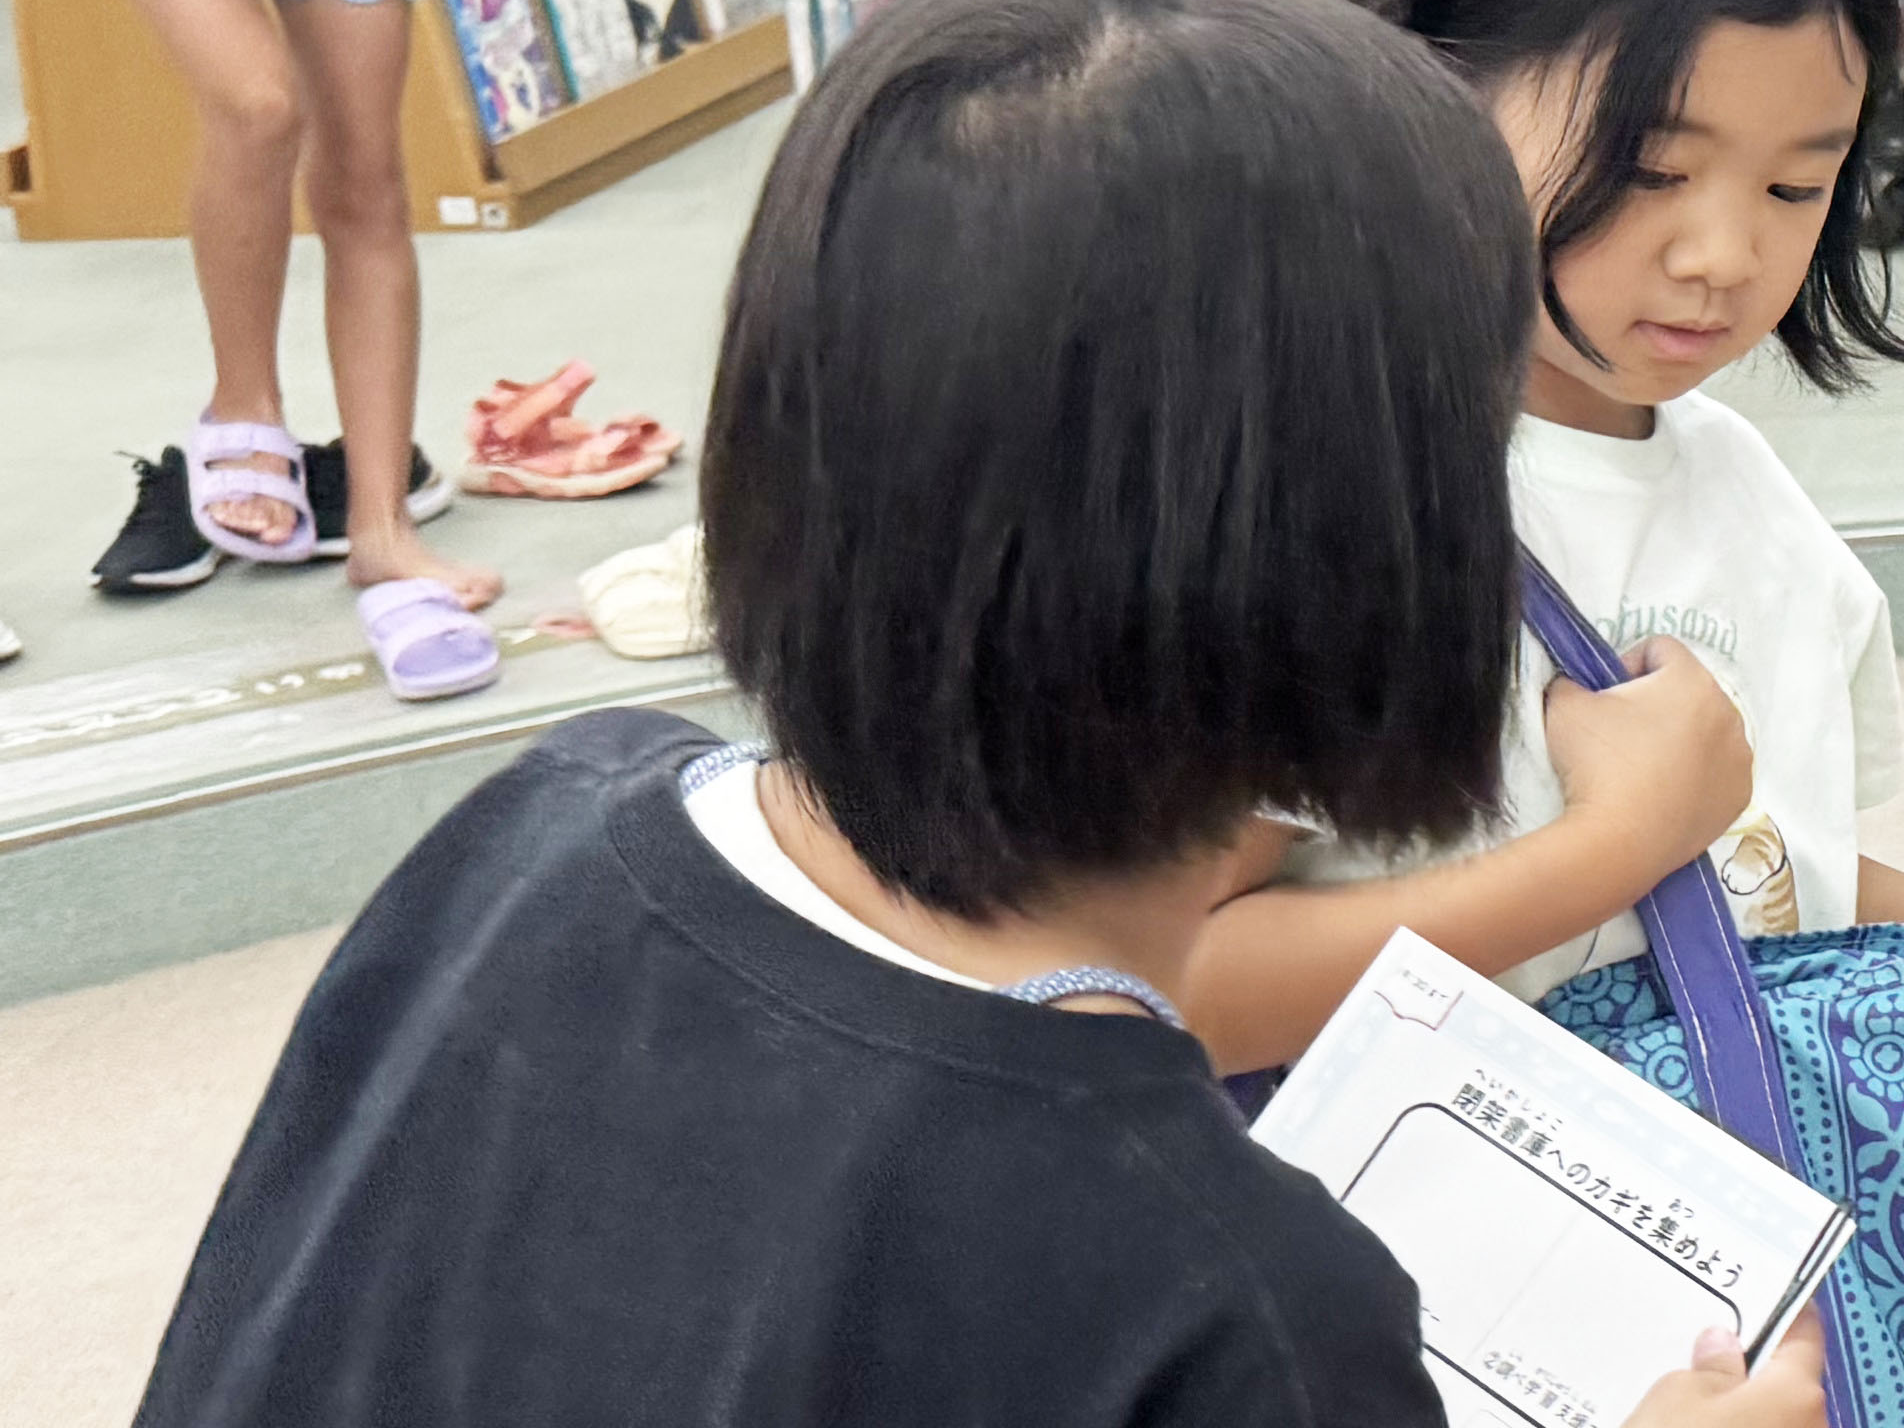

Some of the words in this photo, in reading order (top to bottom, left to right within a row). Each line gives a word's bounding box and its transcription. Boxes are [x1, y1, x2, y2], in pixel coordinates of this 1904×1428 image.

[1452, 1083, 1744, 1287] 閉架書庫へのカギを集めよう
